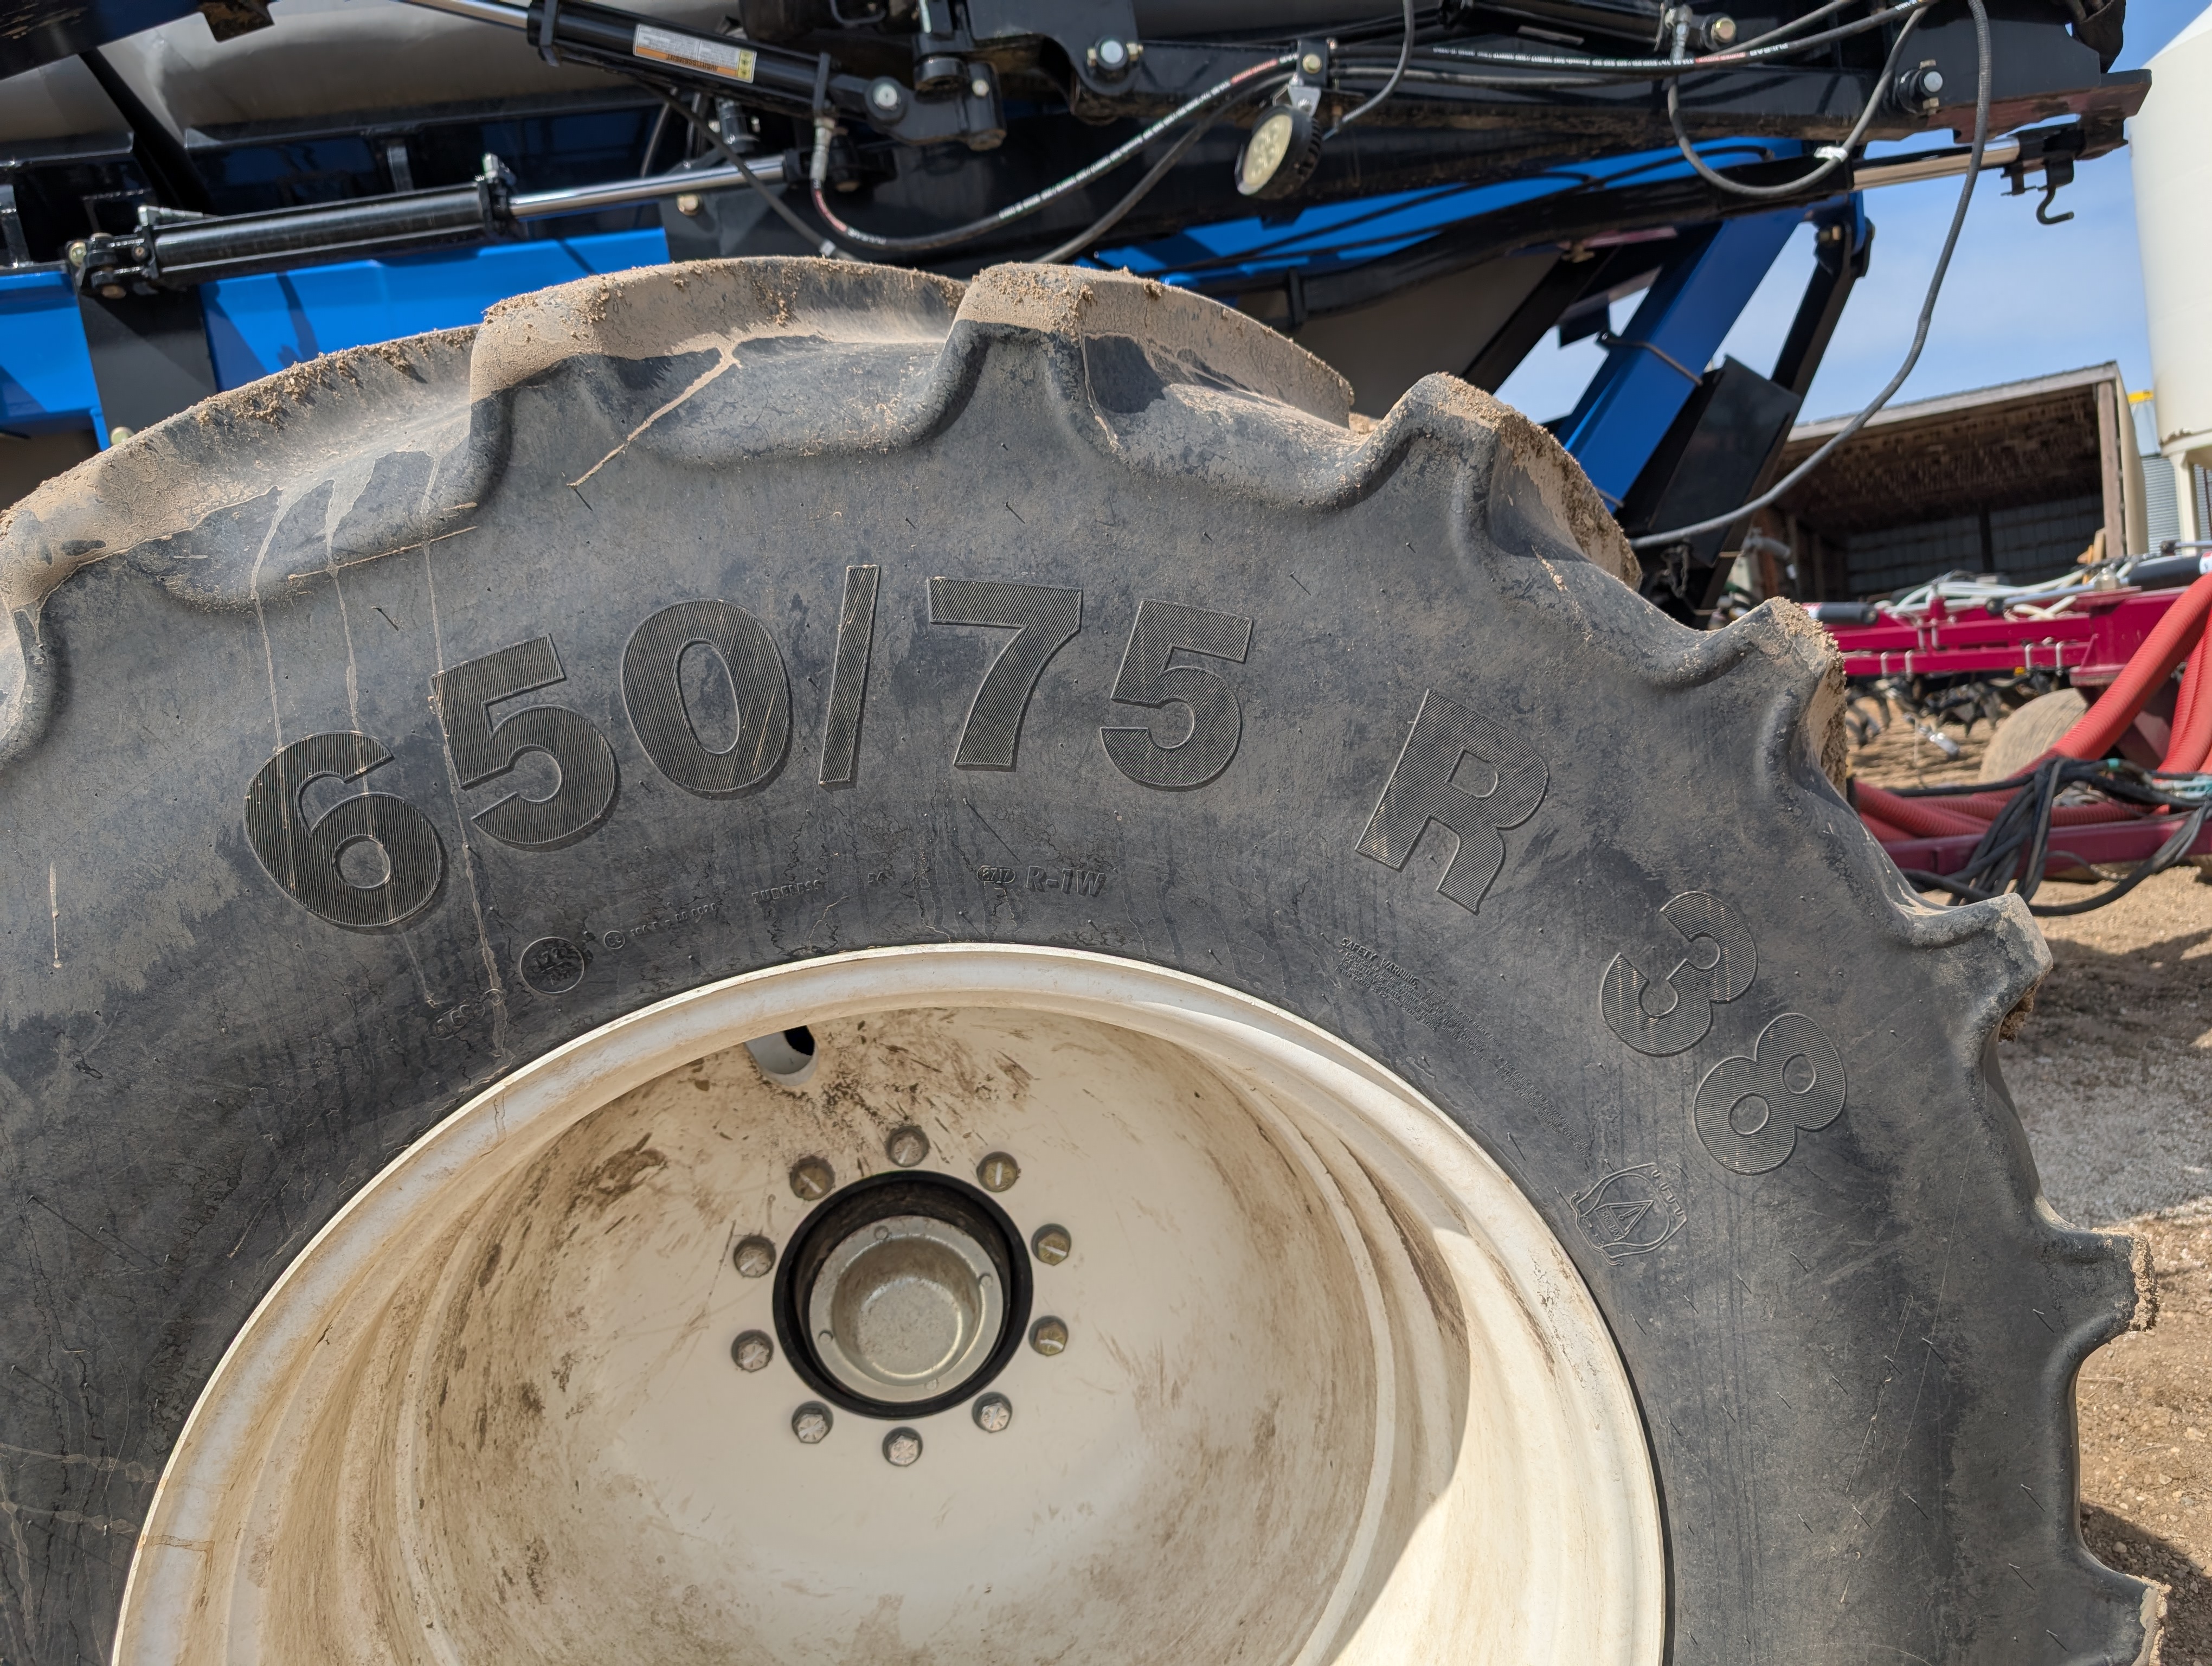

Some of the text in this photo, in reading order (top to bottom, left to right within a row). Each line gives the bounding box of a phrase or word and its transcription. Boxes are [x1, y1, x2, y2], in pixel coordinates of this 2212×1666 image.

[245, 565, 1845, 1175] 650/75 R 38
[1026, 866, 1107, 897] R-1W
[752, 879, 821, 904] TUBELESS
[1340, 934, 1378, 963] SAFETY
